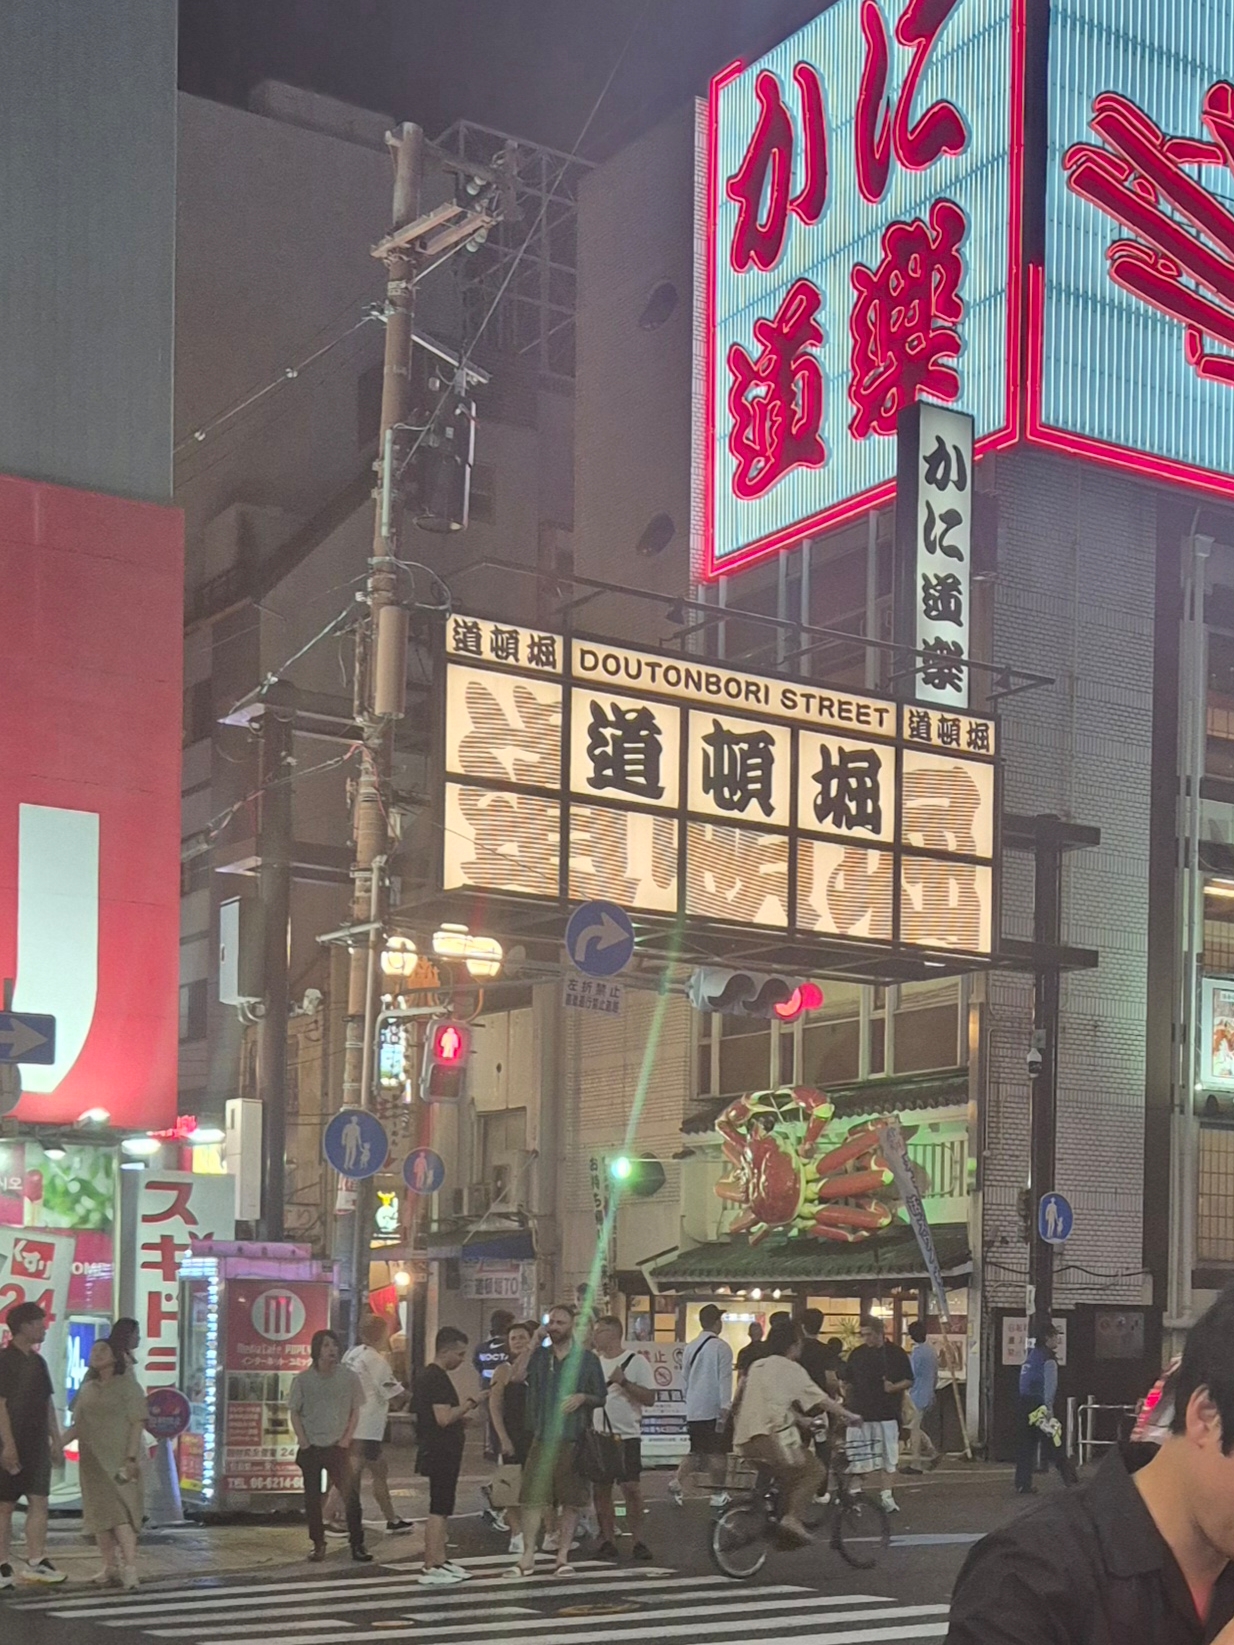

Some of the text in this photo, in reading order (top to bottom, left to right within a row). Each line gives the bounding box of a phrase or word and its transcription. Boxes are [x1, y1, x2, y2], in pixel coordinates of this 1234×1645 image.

[726, 0, 967, 272] かに
[452, 617, 558, 670] 道頓堀
[579, 647, 890, 729] DOUTONBORI STREET
[907, 708, 991, 754] 道頓堀
[586, 698, 883, 836] 道頓堀
[568, 979, 620, 999] 左折禁止
